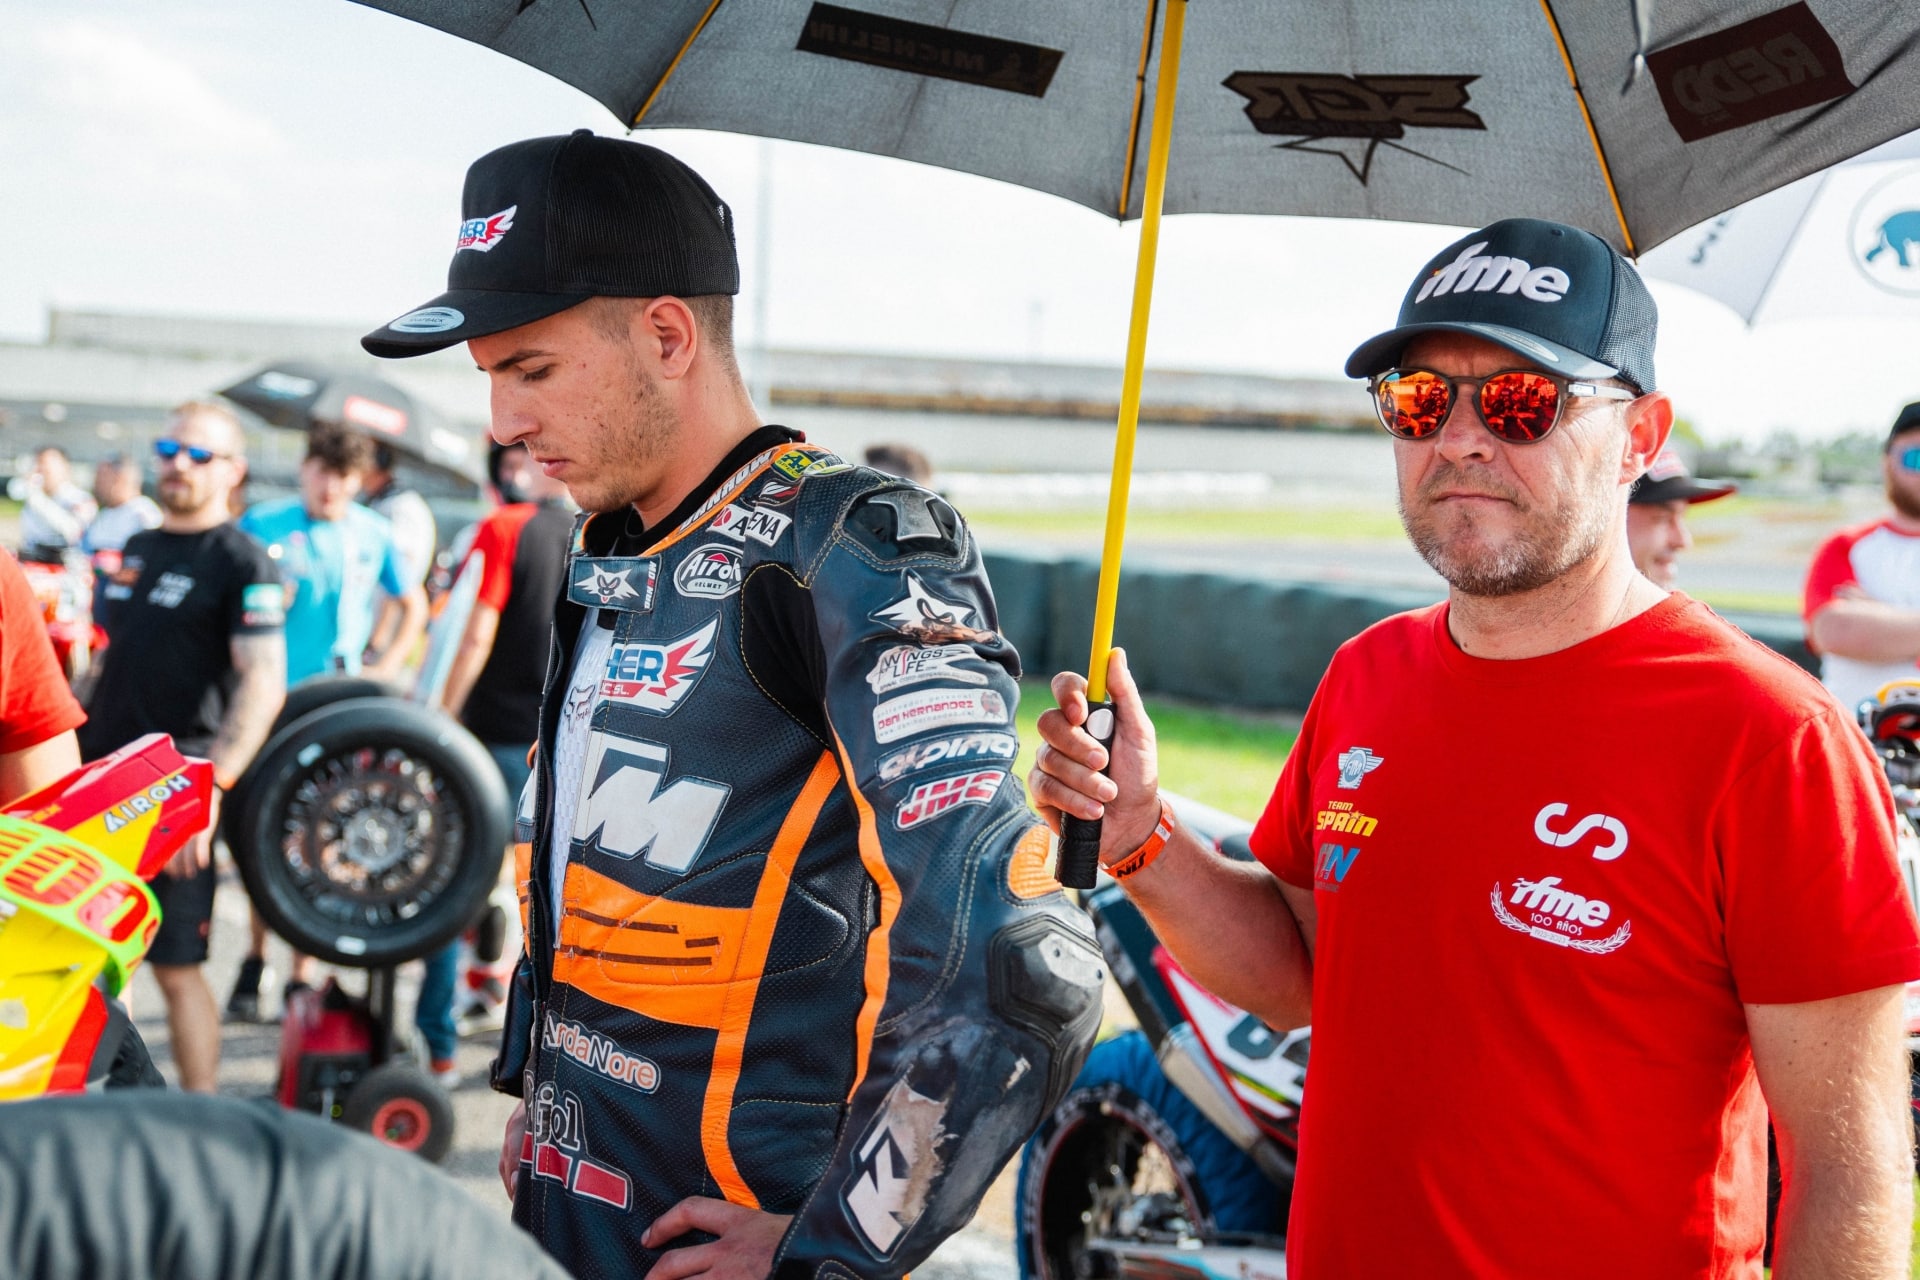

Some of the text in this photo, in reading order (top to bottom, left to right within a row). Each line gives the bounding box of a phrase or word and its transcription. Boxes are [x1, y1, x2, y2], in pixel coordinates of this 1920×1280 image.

[694, 581, 723, 590] HELMET
[882, 649, 943, 668] WINGS
[893, 659, 926, 678] LIFE
[1328, 800, 1354, 811] TEAM
[1510, 876, 1611, 927] rfme
[1530, 912, 1583, 936] 100 AÑOS
